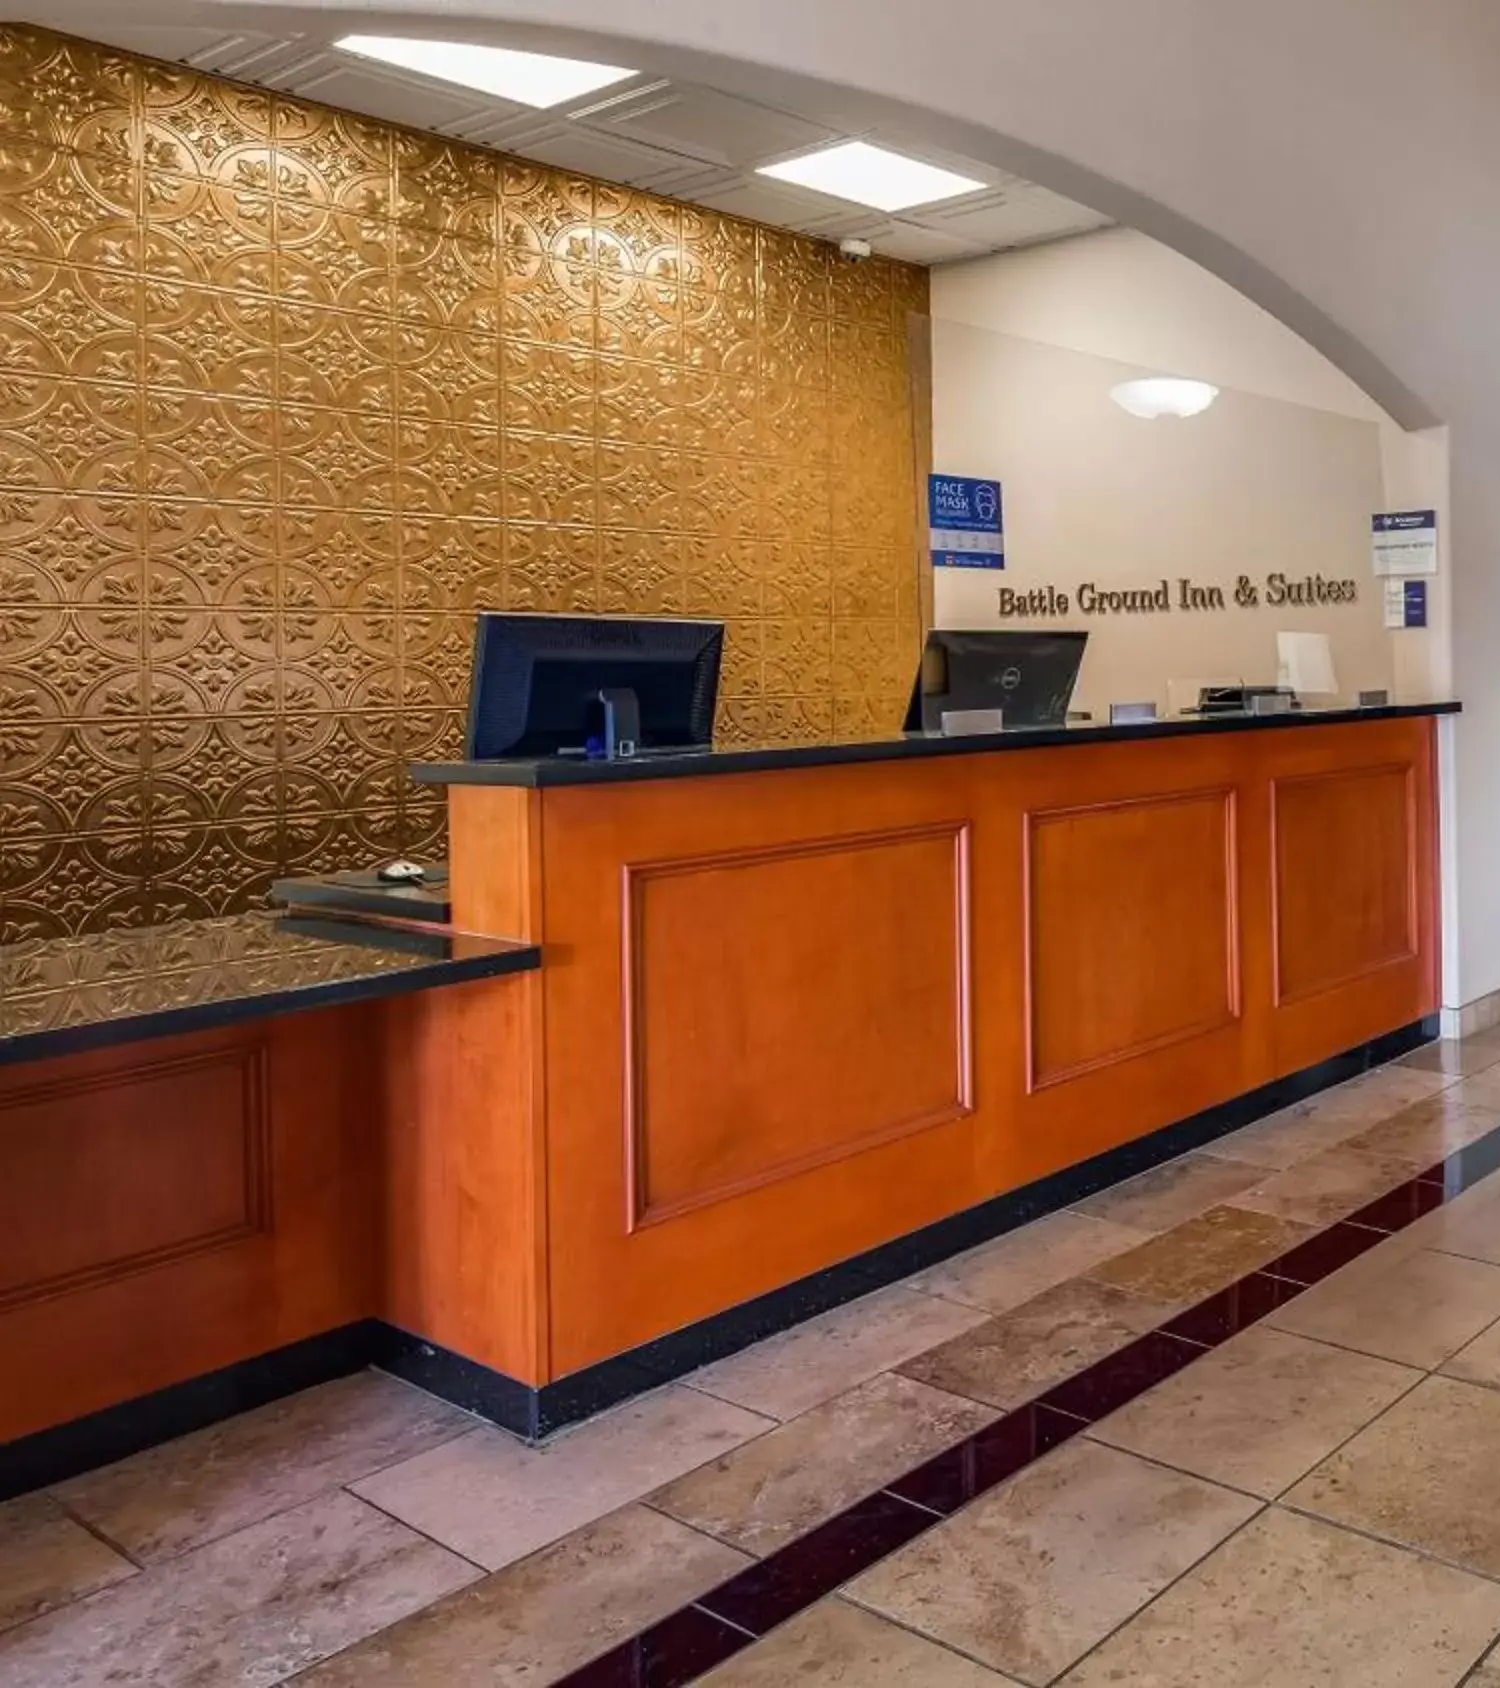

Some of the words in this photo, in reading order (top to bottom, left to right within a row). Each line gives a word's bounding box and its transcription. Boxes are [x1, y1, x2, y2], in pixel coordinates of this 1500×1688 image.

[935, 481, 965, 497] FACE
[935, 495, 969, 510] MASK
[998, 585, 1069, 617] Battle
[1077, 580, 1170, 616] Ground
[1178, 578, 1225, 611] Inn
[1233, 575, 1259, 608] &
[1265, 572, 1358, 607] Suites
